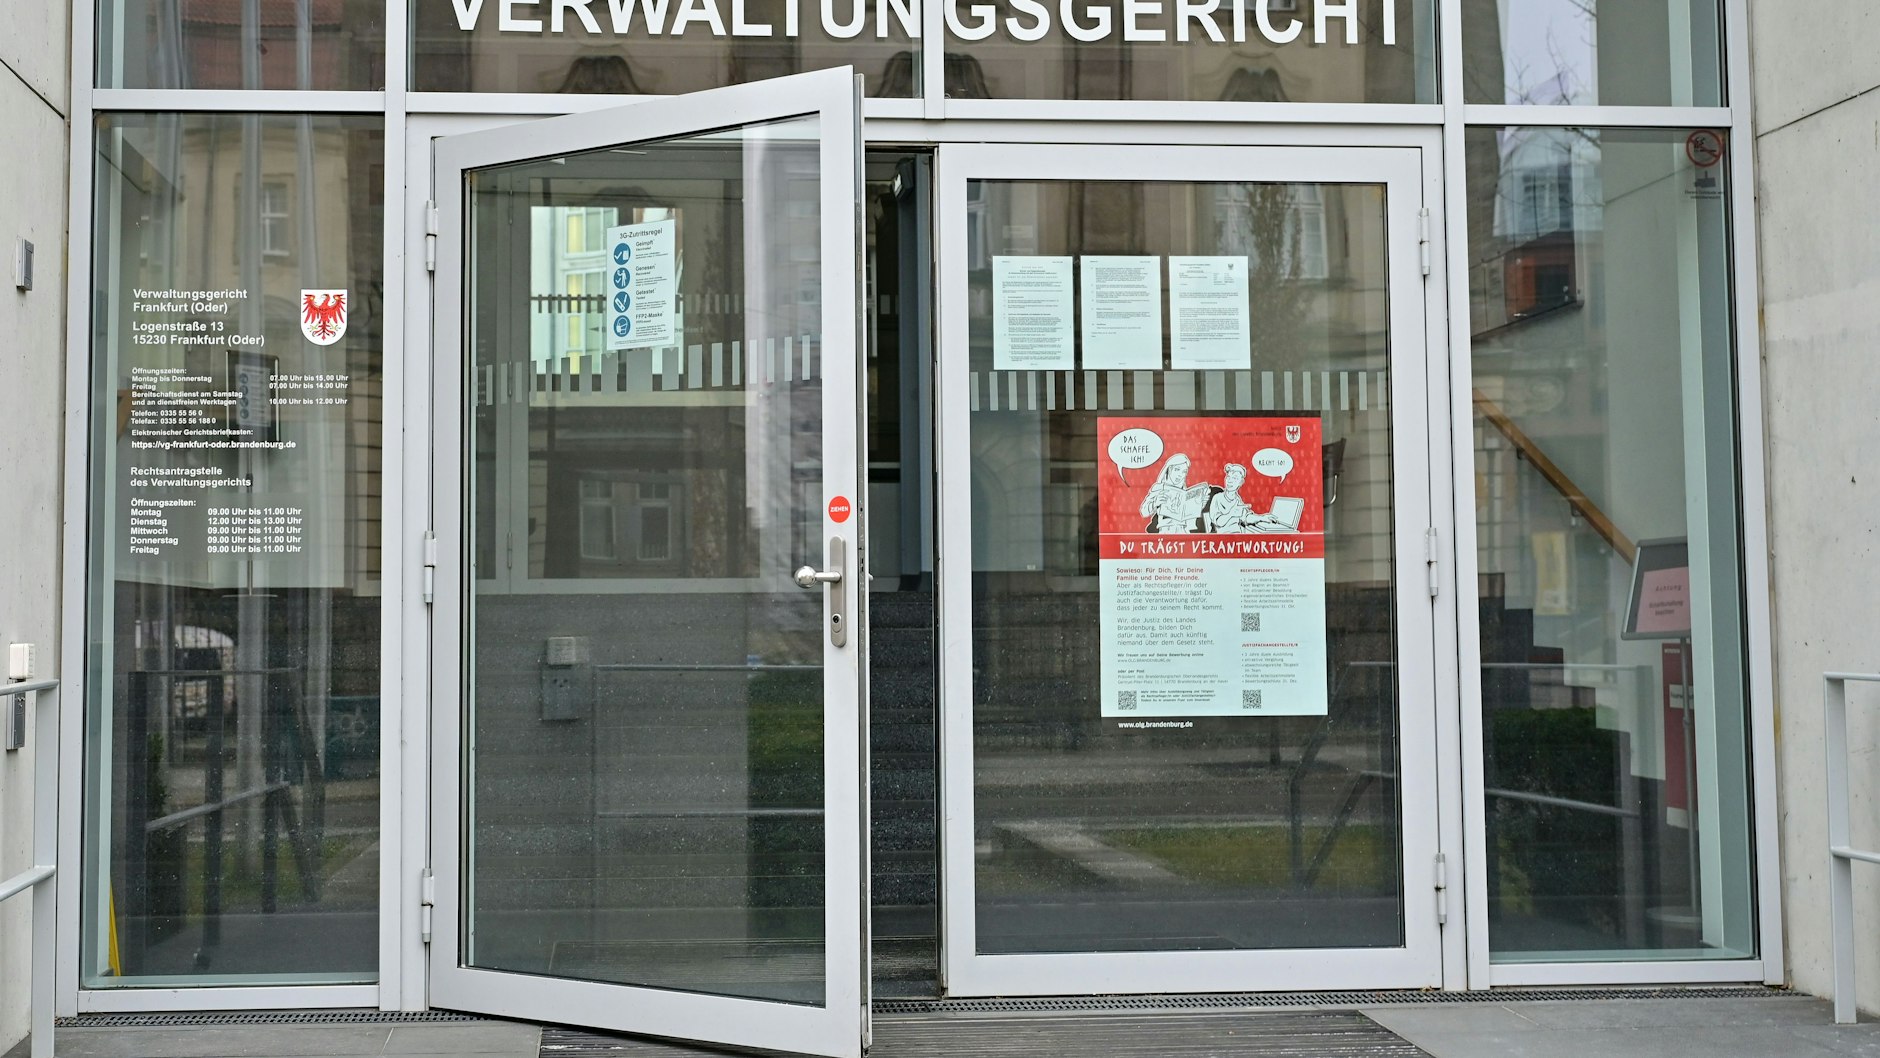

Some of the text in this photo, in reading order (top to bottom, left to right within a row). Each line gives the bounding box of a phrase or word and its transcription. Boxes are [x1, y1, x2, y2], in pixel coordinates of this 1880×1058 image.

[619, 227, 663, 240] 3G-Zutrittsregel
[133, 288, 248, 300] Verwaltungsgericht
[133, 302, 228, 314] Frankfurt (Oder)
[132, 321, 224, 333] Logenstraße 13
[132, 335, 265, 347] 15230 Frankfurt (Oder)
[132, 367, 187, 375] Öffnungszeiten:
[270, 374, 288, 382] 07.00
[290, 374, 302, 382] Uhr
[304, 374, 314, 382] bis
[316, 374, 334, 382] 15.00
[336, 374, 348, 382] Uhr
[1123, 435, 1137, 444] DAS
[132, 440, 296, 450] https://vg-frankfurt-oder.brandenburg.de
[1120, 445, 1151, 454] SCHAFFE
[1130, 455, 1145, 463] ICH!
[130, 466, 222, 477] Rechtsantragstelle
[130, 478, 251, 488] des Verwaltungsgerichts
[130, 498, 196, 508] Öffnungszeiten:
[130, 508, 302, 518] Montag 09.00 Uhr bis 11.00 Uhr
[130, 517, 302, 527] Dienstag 12.00 Uhr bis 13.00 Uhr
[130, 526, 302, 535] Mittwoch 09.00 Uhr bis 11.00 Uhr
[130, 536, 302, 546] Donnerstag 09.00 Uhr bis 11.00 Uhr
[1120, 538, 1304, 554] DU TRÄGST VERANTWORTUNG!
[130, 545, 302, 555] Freitag 09.00 Uhr bis 11.00 Uhr
